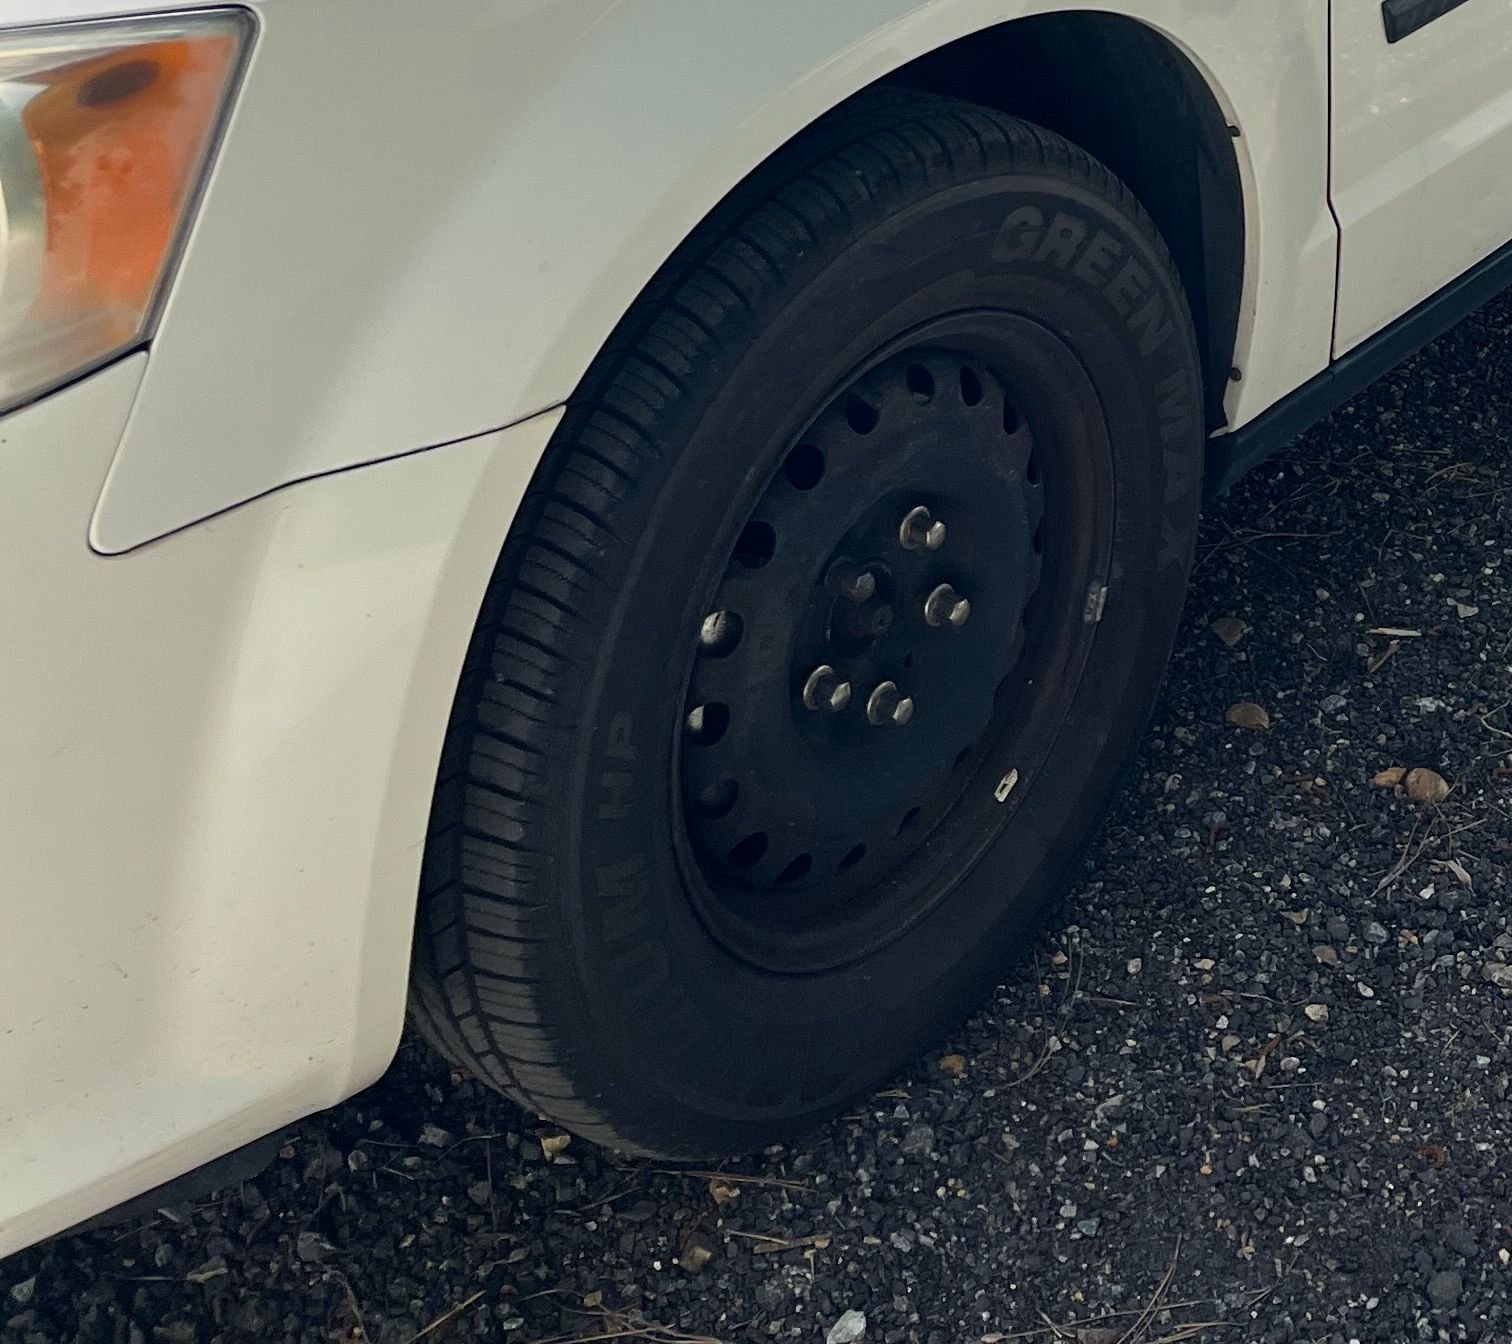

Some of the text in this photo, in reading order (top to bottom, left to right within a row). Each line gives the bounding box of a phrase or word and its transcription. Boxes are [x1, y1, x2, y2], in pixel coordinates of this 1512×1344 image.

[991, 205, 1190, 573] GREEN MAX
[597, 710, 637, 820] HP
